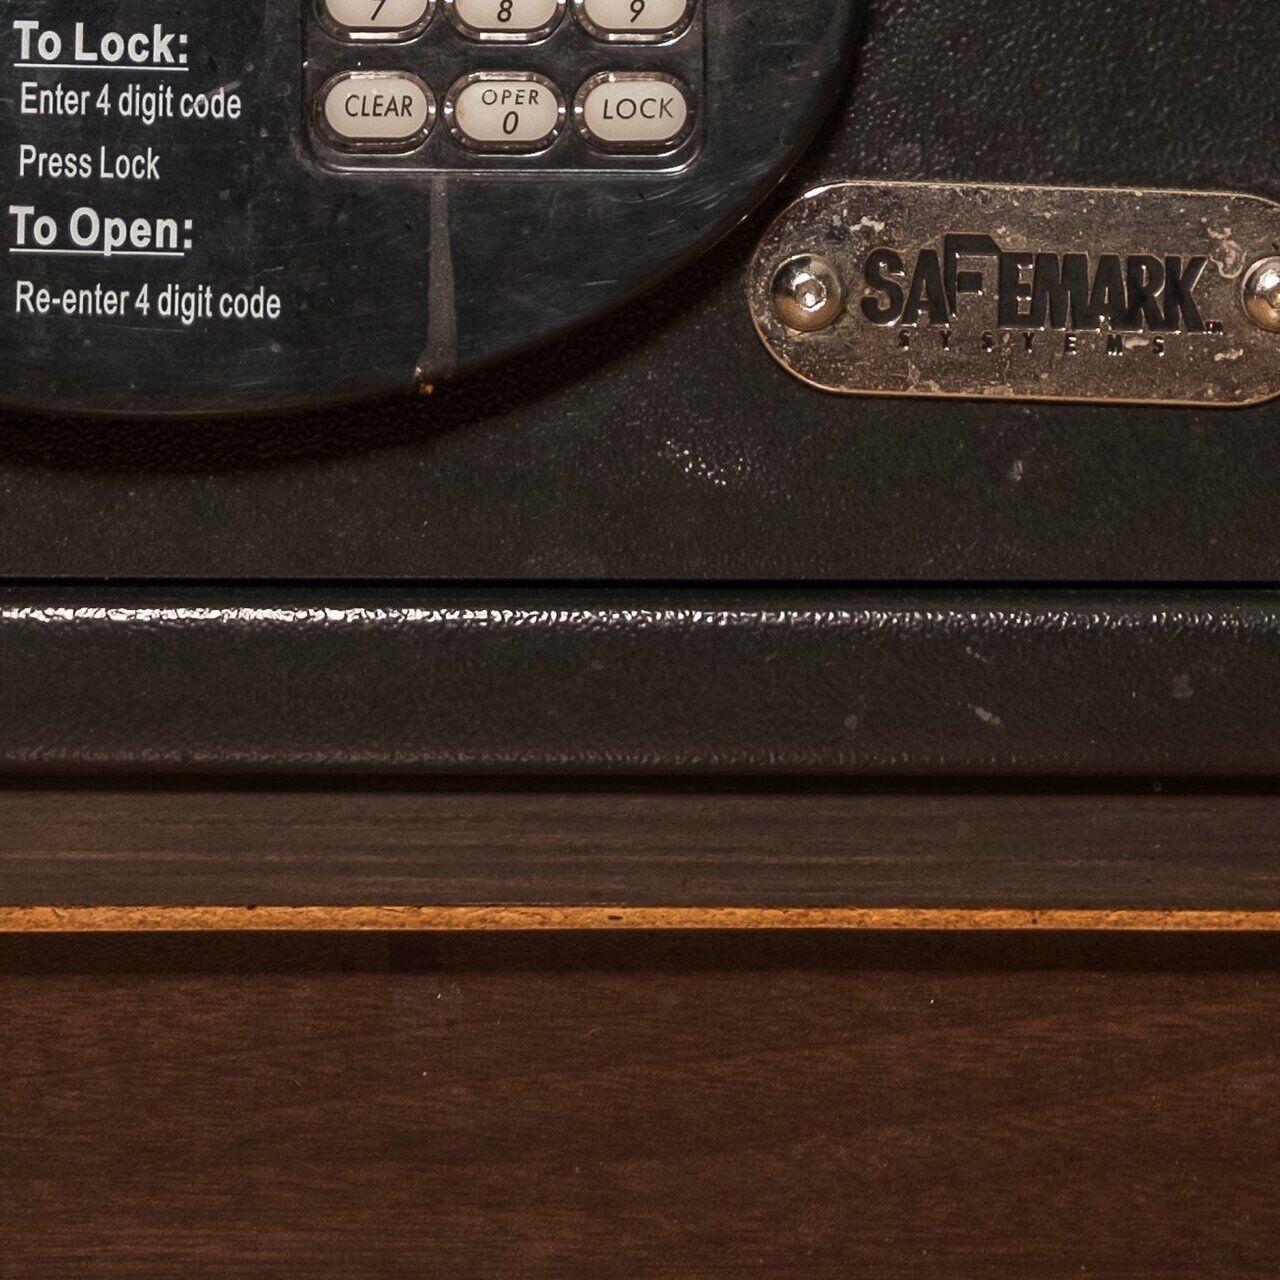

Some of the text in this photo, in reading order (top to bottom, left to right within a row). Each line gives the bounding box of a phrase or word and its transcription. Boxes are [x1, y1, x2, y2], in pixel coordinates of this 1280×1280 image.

[12, 19, 188, 64] To Lock:
[20, 81, 242, 126] Enter 4 digit code
[344, 93, 413, 118] CLEAR
[481, 88, 540, 106] OPER
[602, 97, 675, 120] LOCK
[19, 143, 160, 180] Press Lock
[8, 204, 193, 257] To Open:
[15, 280, 281, 326] Re-enter 4 digit code
[860, 233, 1208, 331] SAFEMARK
